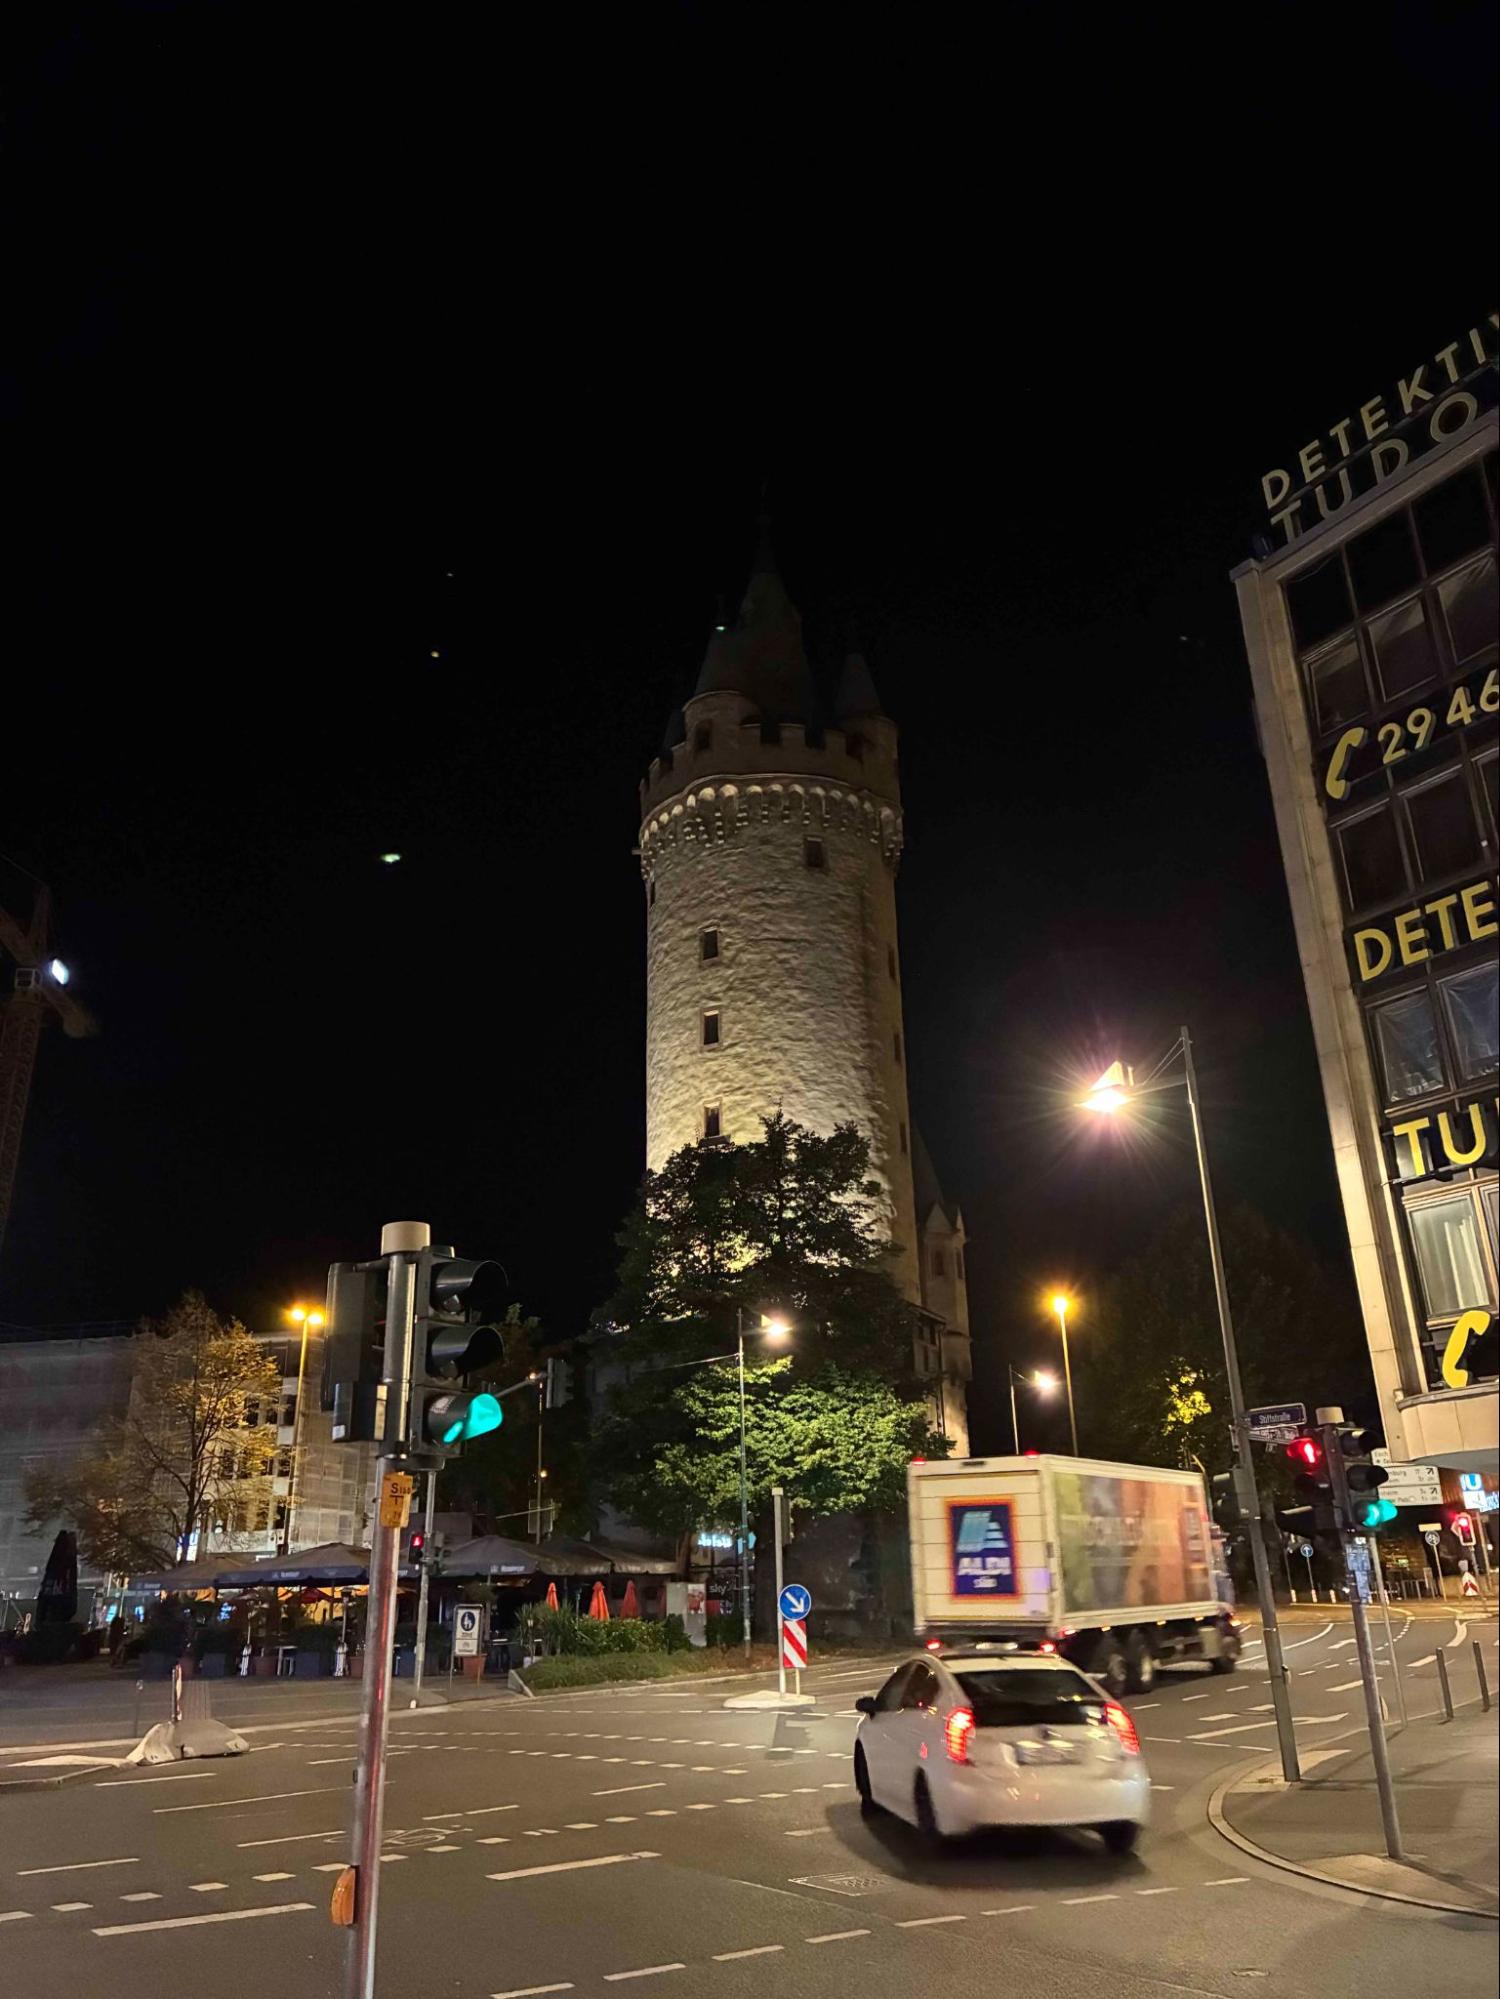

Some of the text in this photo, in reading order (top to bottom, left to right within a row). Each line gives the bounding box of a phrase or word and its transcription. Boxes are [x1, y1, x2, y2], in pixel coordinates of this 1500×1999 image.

[1377, 669, 1499, 765] 29 46
[1466, 1474, 1482, 1490] U
[958, 1556, 1012, 1576] ALDI
